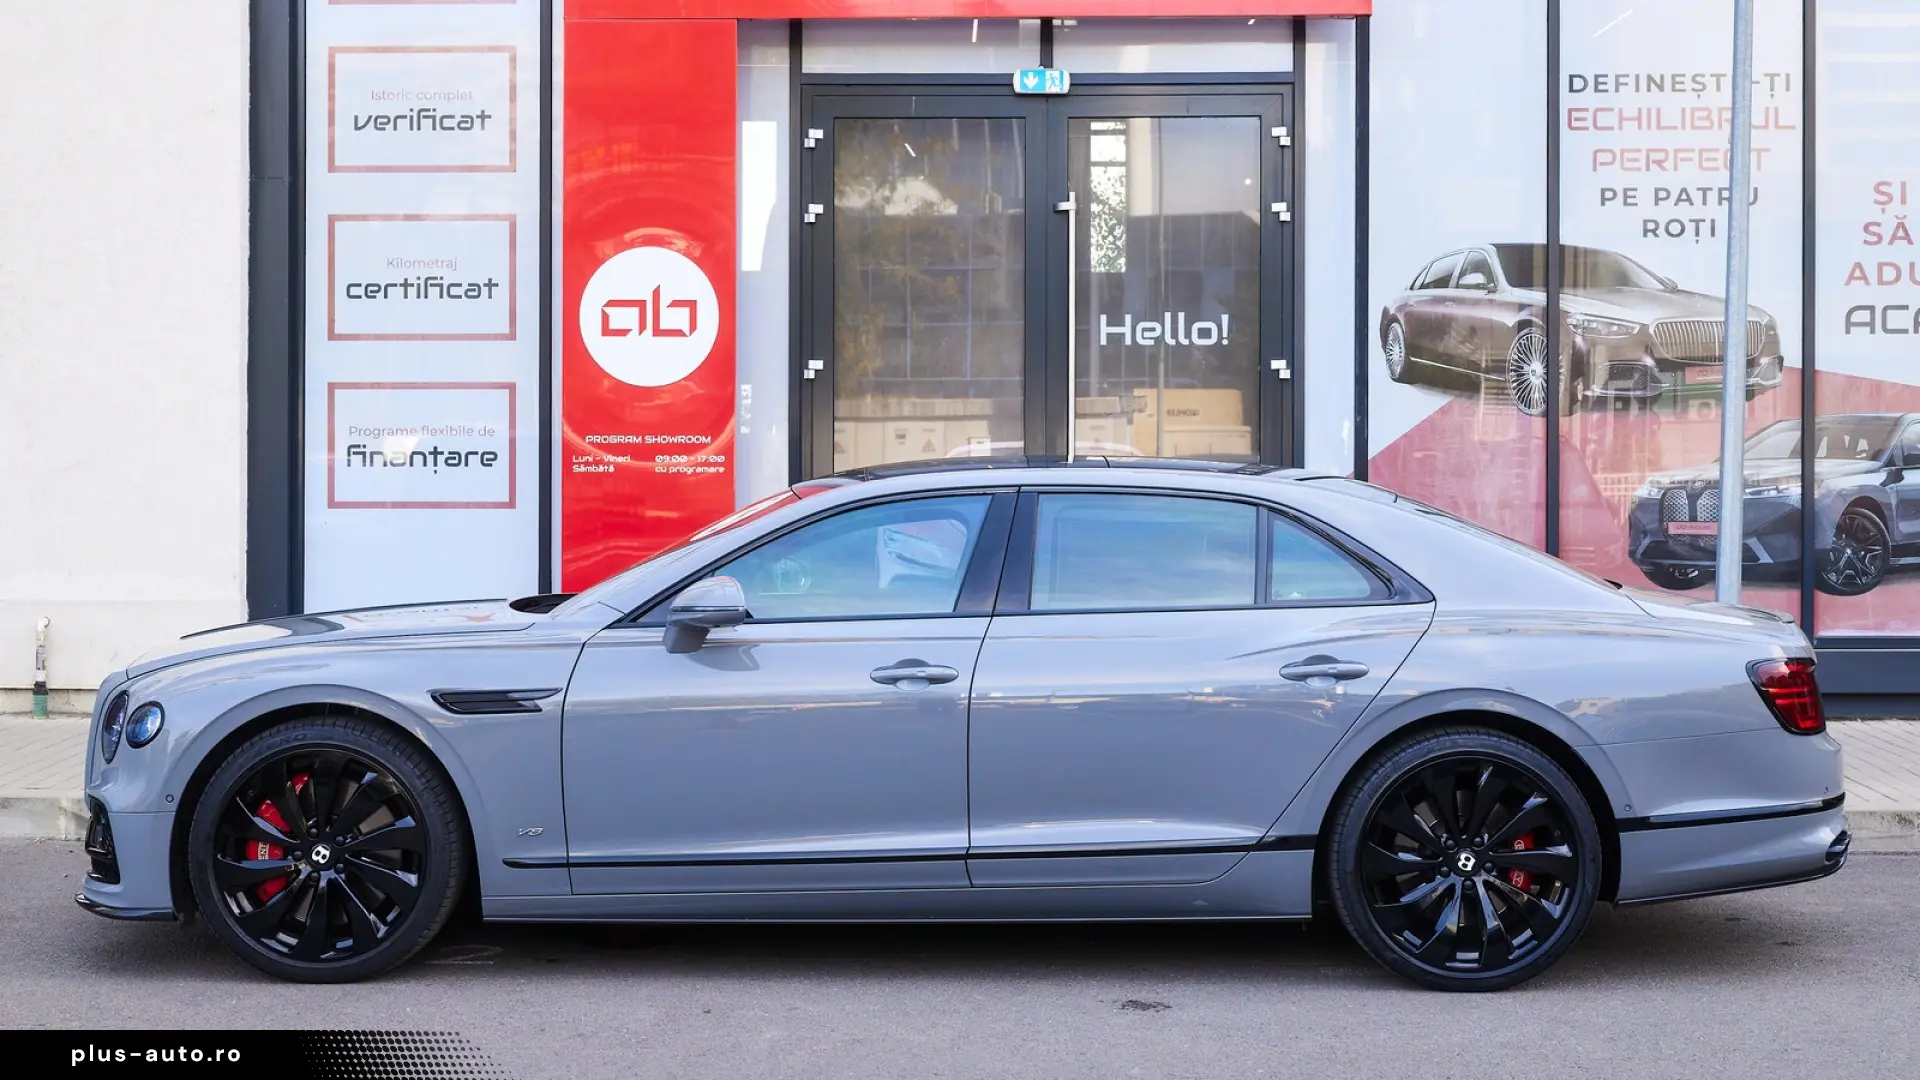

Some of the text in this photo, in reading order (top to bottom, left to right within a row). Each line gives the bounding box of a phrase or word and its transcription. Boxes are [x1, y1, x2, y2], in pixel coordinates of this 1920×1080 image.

[371, 89, 473, 103] Istoric complet
[1568, 73, 1791, 99] DEFINEȘT-ȚI
[353, 108, 492, 131] verificat
[1600, 187, 1639, 207] PE
[1873, 180, 1908, 214] ȘI
[1642, 218, 1716, 244] ROȚI
[1862, 214, 1915, 246] SĂ
[386, 257, 458, 270] Kilometraj
[346, 276, 499, 299] certificat
[1099, 311, 1230, 346] Hello!
[1845, 304, 1920, 335] AC
[348, 425, 496, 439] Programe flexibile de
[585, 435, 711, 444] PROGRAM SHOWROOM
[346, 443, 499, 474] finanțare
[572, 455, 594, 463] Luni
[655, 455, 688, 463] 09:00
[697, 455, 726, 463] 17:00
[669, 466, 726, 475] programare
